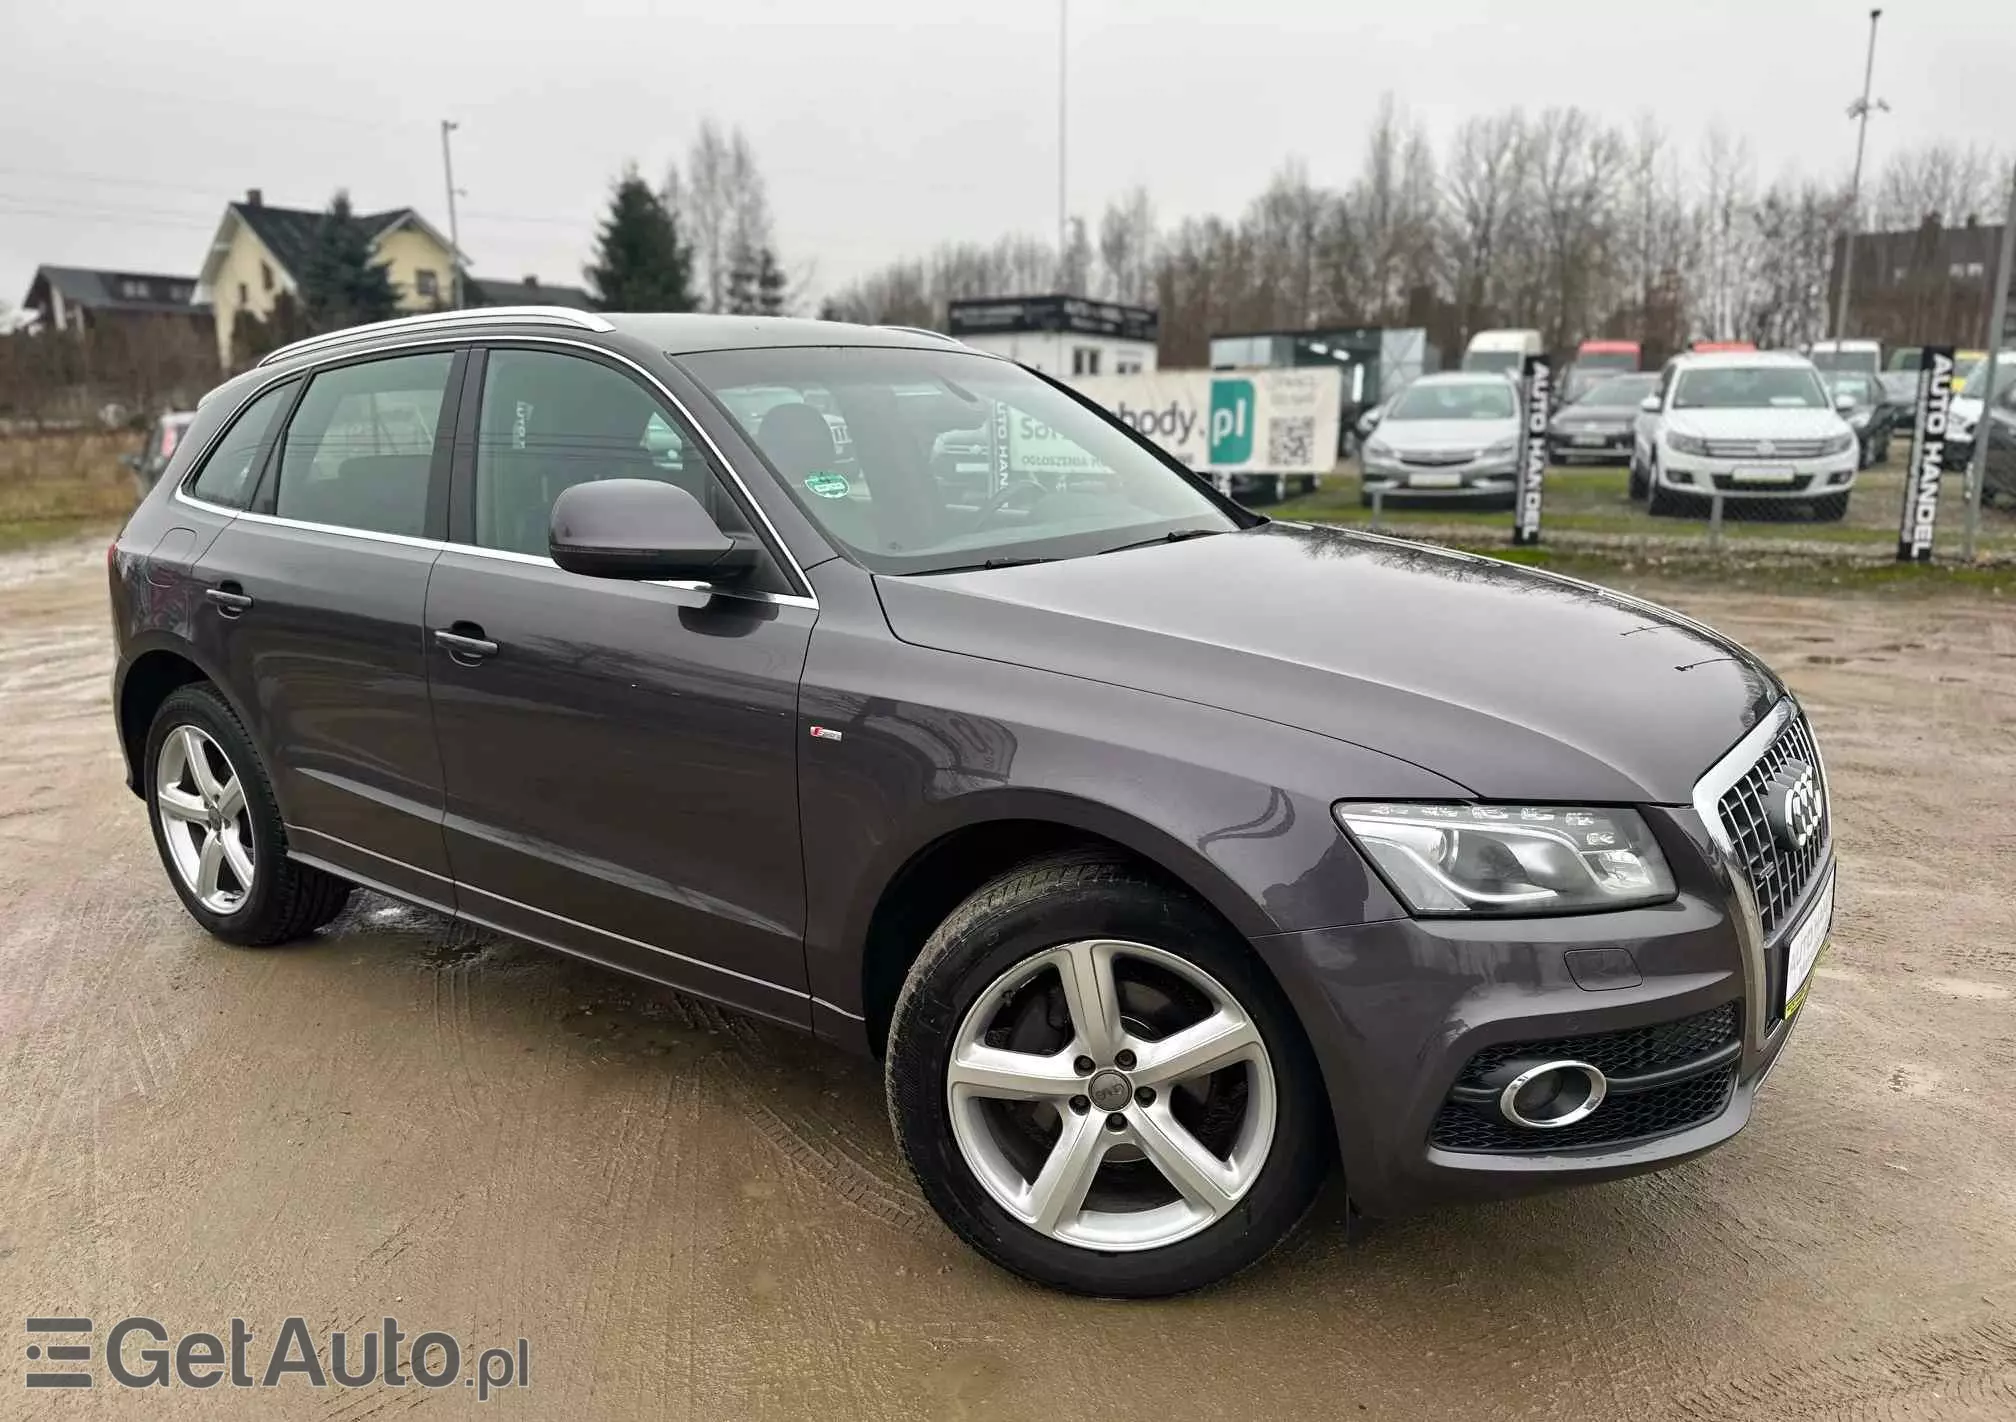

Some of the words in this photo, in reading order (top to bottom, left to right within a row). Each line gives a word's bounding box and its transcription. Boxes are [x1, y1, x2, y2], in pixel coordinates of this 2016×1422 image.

[1529, 361, 1550, 433] AUTO
[1926, 353, 1954, 434] AUTO
[1522, 437, 1546, 541] HANDEL
[1910, 441, 1945, 558] HANDEL
